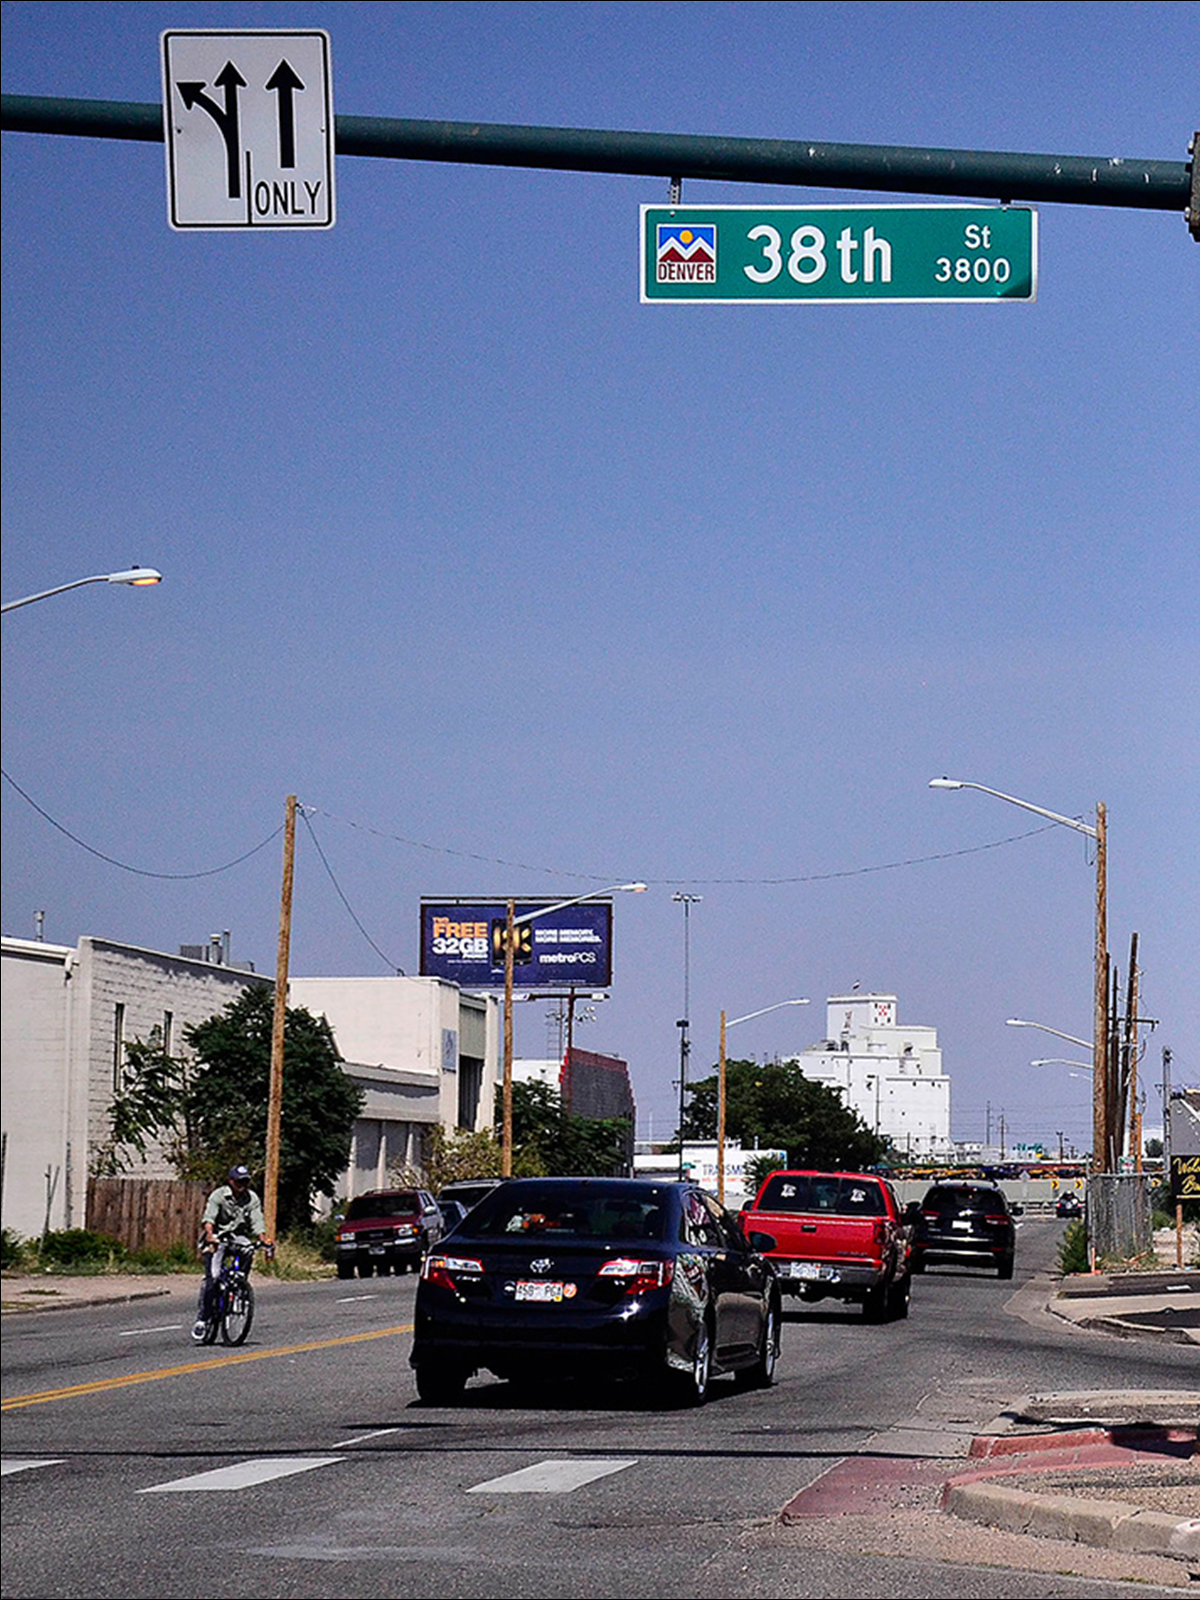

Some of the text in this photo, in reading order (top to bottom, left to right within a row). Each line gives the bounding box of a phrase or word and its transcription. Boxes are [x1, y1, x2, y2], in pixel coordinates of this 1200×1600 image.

[255, 181, 321, 215] ONLY
[743, 224, 991, 284] 38th St
[658, 263, 715, 282] DENVER
[934, 257, 1011, 283] 3800
[433, 922, 488, 938] FREE
[432, 938, 489, 955] 32GB
[539, 951, 596, 963] metroPCS
